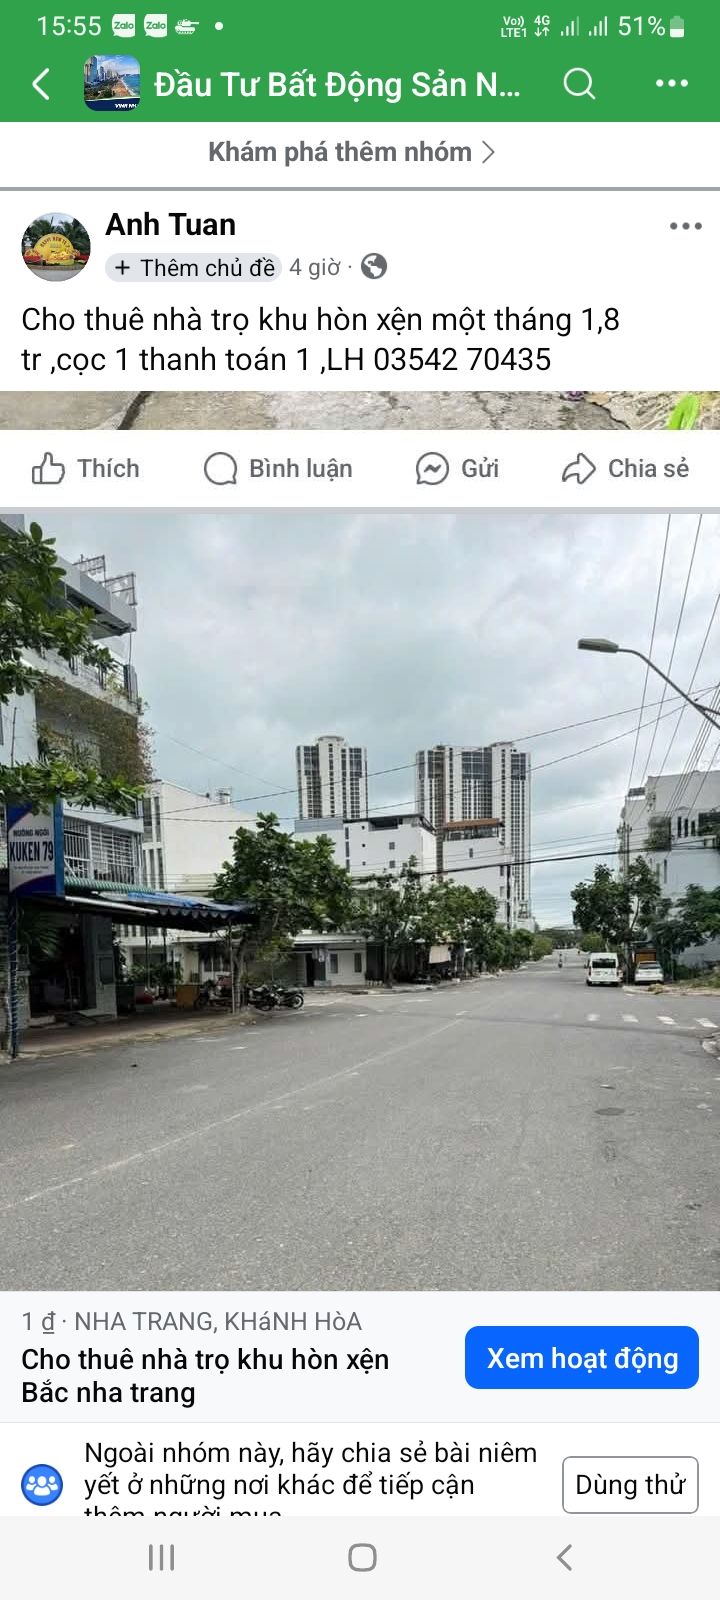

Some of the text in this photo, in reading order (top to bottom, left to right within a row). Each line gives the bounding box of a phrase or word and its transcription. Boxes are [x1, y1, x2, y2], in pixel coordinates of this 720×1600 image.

[37, 15, 101, 36] 15:55
[114, 21, 134, 30] Zalo
[146, 21, 166, 30] Zalo
[500, 28, 527, 38] LTE1
[534, 15, 550, 26] 4G
[618, 15, 666, 36] 51%
[154, 69, 211, 97] Đầu
[220, 71, 261, 97] Tư
[269, 69, 317, 97] Bất
[325, 70, 402, 104] Động
[412, 69, 467, 97] Sản
[208, 140, 472, 167] Khám phá thêm nhóm
[105, 211, 235, 236] Anh Tuan
[140, 256, 276, 277] Thêm chủ đề
[289, 257, 342, 281] 4 giờ
[22, 305, 620, 337] Cho thuê nhà trọ khu hòn xện một tháng 1,8
[21, 346, 551, 376] tr ,cọc 1 thanh toán 1 ,LH 03542 70435
[77, 457, 140, 478] Thích
[250, 457, 353, 483] Bình luận
[461, 456, 499, 478] Gửi
[608, 455, 690, 478] Chia sẻ
[9, 841, 54, 862] KUKEN 79
[22, 1311, 31, 1331] 1
[75, 1311, 127, 1331] NHA
[132, 1311, 218, 1335] TRANG,
[226, 1310, 307, 1331] KHáNH
[316, 1310, 363, 1331] HòA
[22, 1347, 389, 1375] Cho thuê nhà trọ khu hòn xện
[487, 1345, 680, 1376] Xem hoạt động
[22, 1378, 195, 1409] Bắc nha trang
[85, 1440, 537, 1468] Ngoài nhóm này, hãy chia sẻ bài niêm
[84, 1470, 474, 1500] yết ở những nơi khác để tiếp cận
[576, 1471, 687, 1500] Dùng thử
